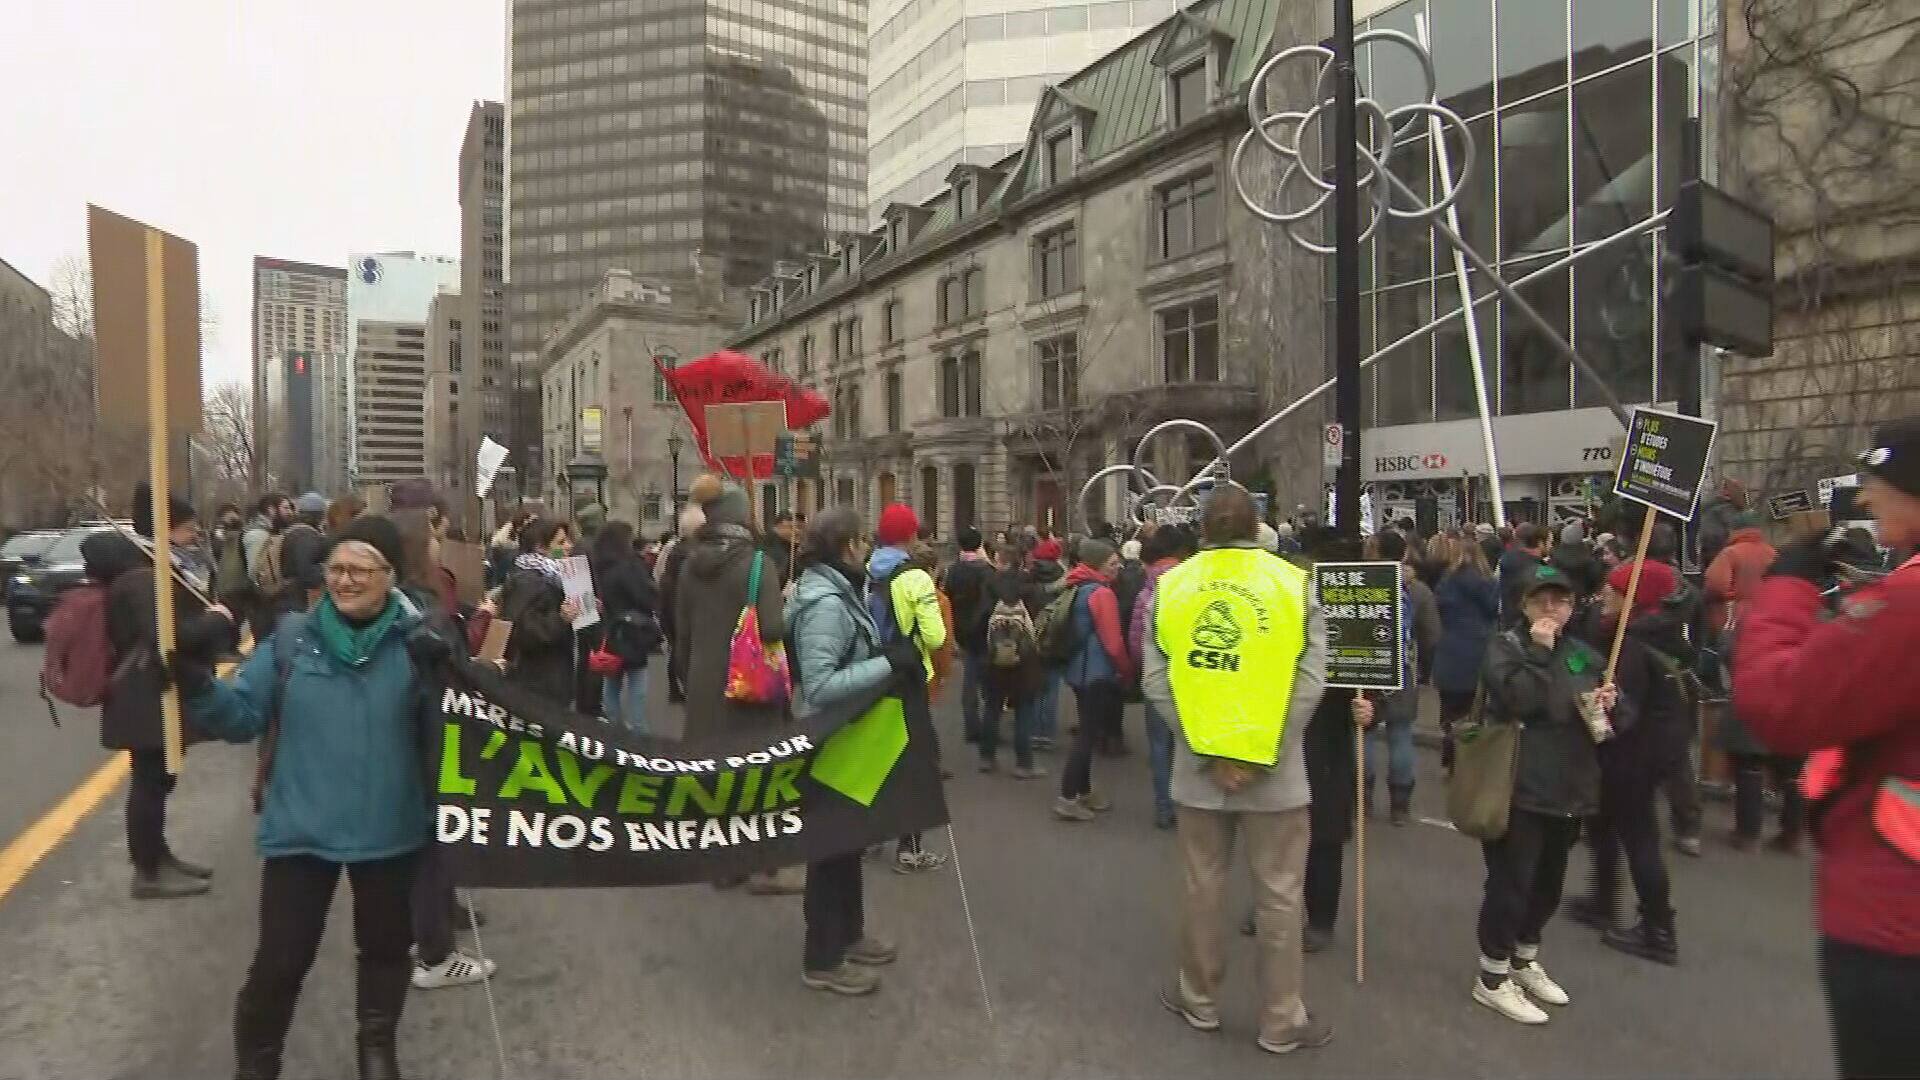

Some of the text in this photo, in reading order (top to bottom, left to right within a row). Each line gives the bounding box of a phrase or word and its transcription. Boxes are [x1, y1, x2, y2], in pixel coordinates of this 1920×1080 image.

[1643, 418, 1660, 432] PLUS
[1582, 447, 1611, 461] 770
[1375, 455, 1420, 473] HSBC
[1321, 571, 1366, 586] PAS DE
[1210, 580, 1269, 634] SYNDICALE
[1321, 604, 1392, 619] SANS BAPE
[1187, 650, 1240, 671] CSN
[441, 687, 814, 773] MÈRES AU FRONT POUR
[438, 723, 806, 816] L'AVENIR
[437, 804, 804, 853] DE NOS ENFANTS
